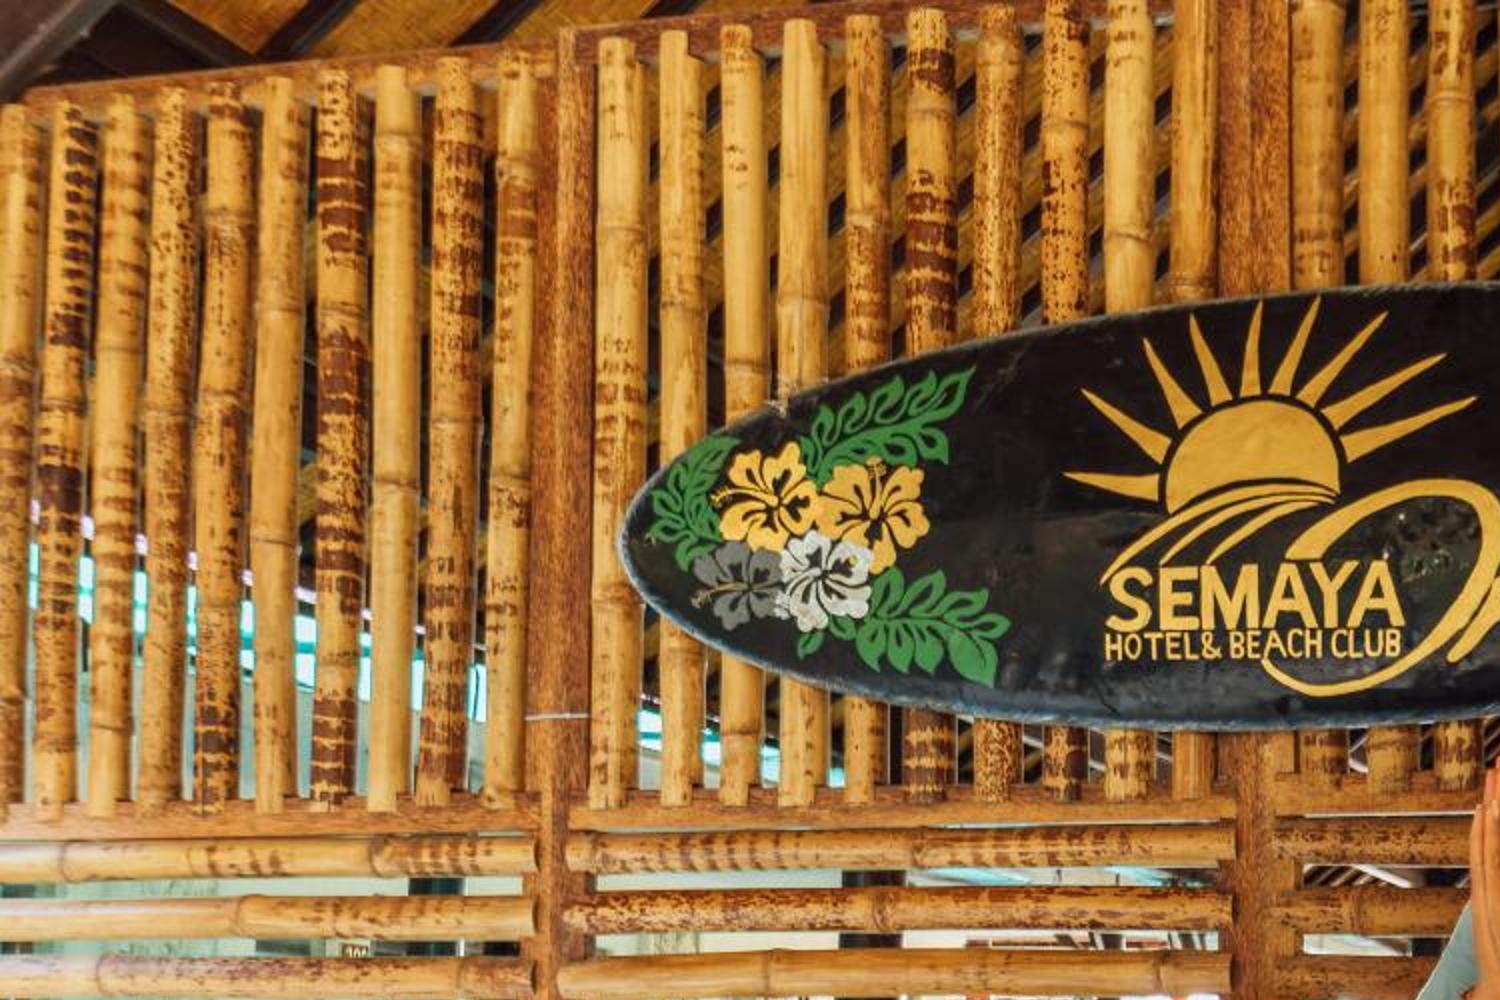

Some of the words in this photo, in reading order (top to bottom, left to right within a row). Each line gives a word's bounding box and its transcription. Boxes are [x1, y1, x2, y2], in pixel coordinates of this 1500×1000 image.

[1105, 559, 1406, 633] SEMAYA
[1229, 629, 1323, 660] BEACH
[1330, 628, 1401, 659] CLUB
